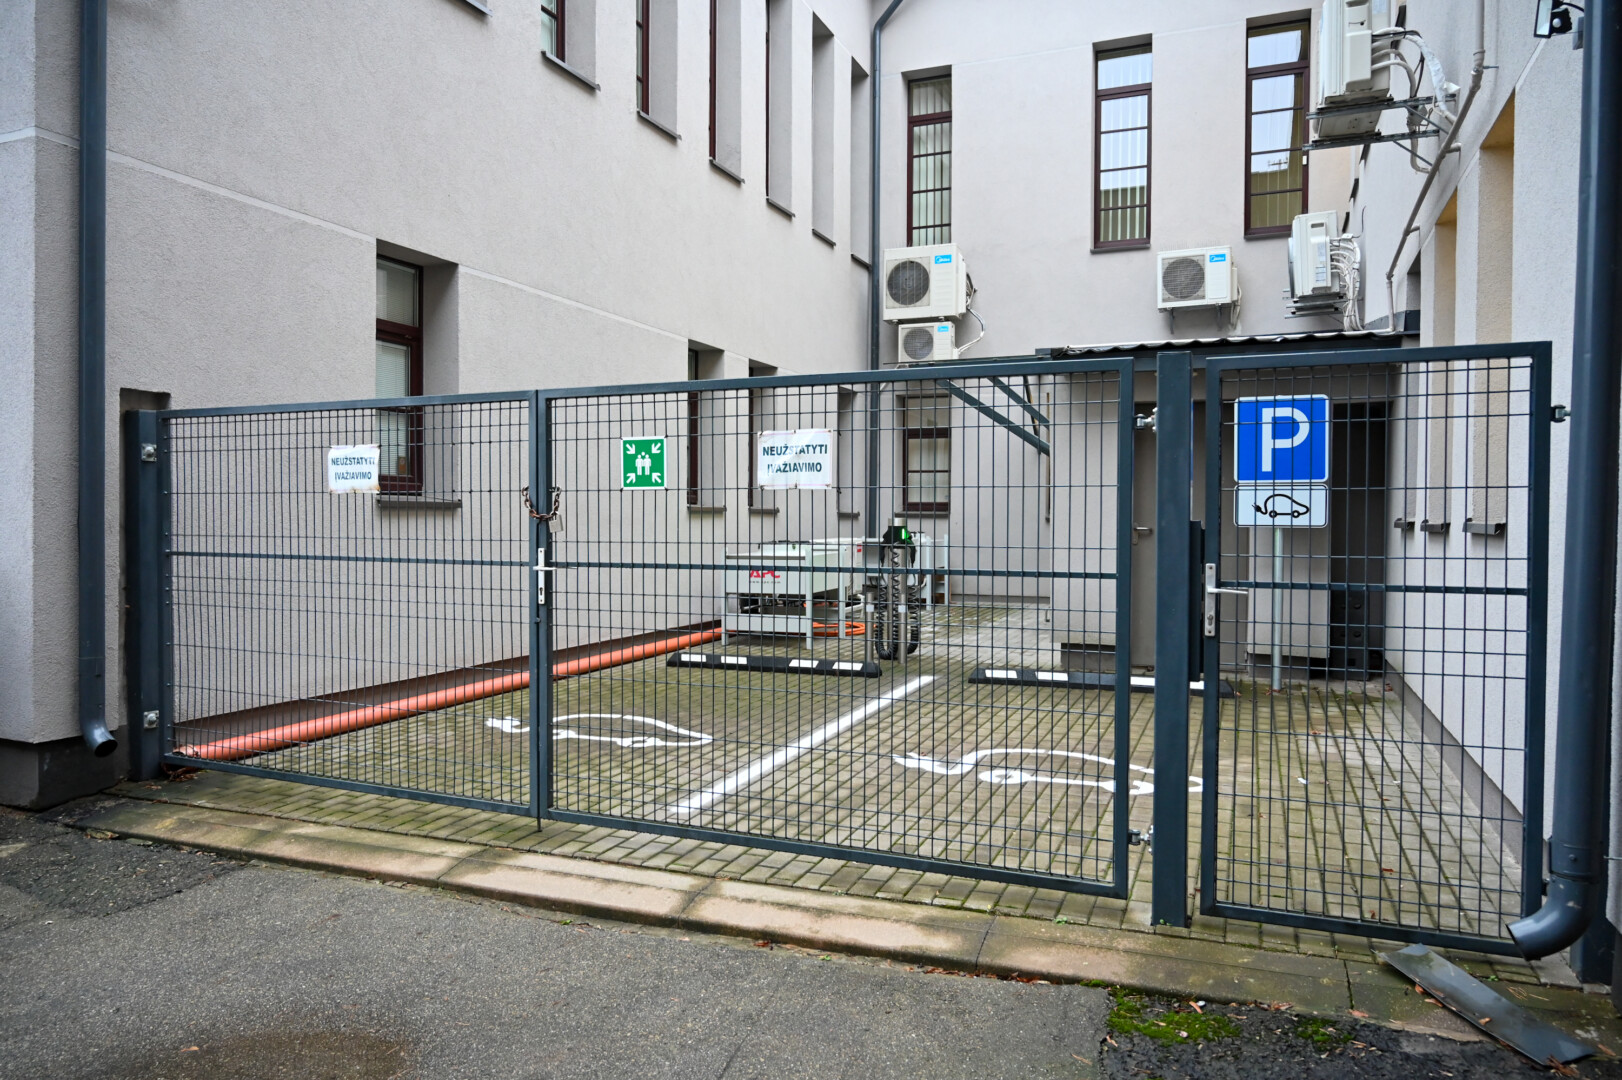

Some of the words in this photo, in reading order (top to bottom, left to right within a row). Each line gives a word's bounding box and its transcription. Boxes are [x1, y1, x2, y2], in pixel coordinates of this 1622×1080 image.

[1262, 407, 1310, 472] P
[763, 444, 828, 456] NEUŽSTATYTI
[331, 456, 375, 466] NEUŽSTATYTI
